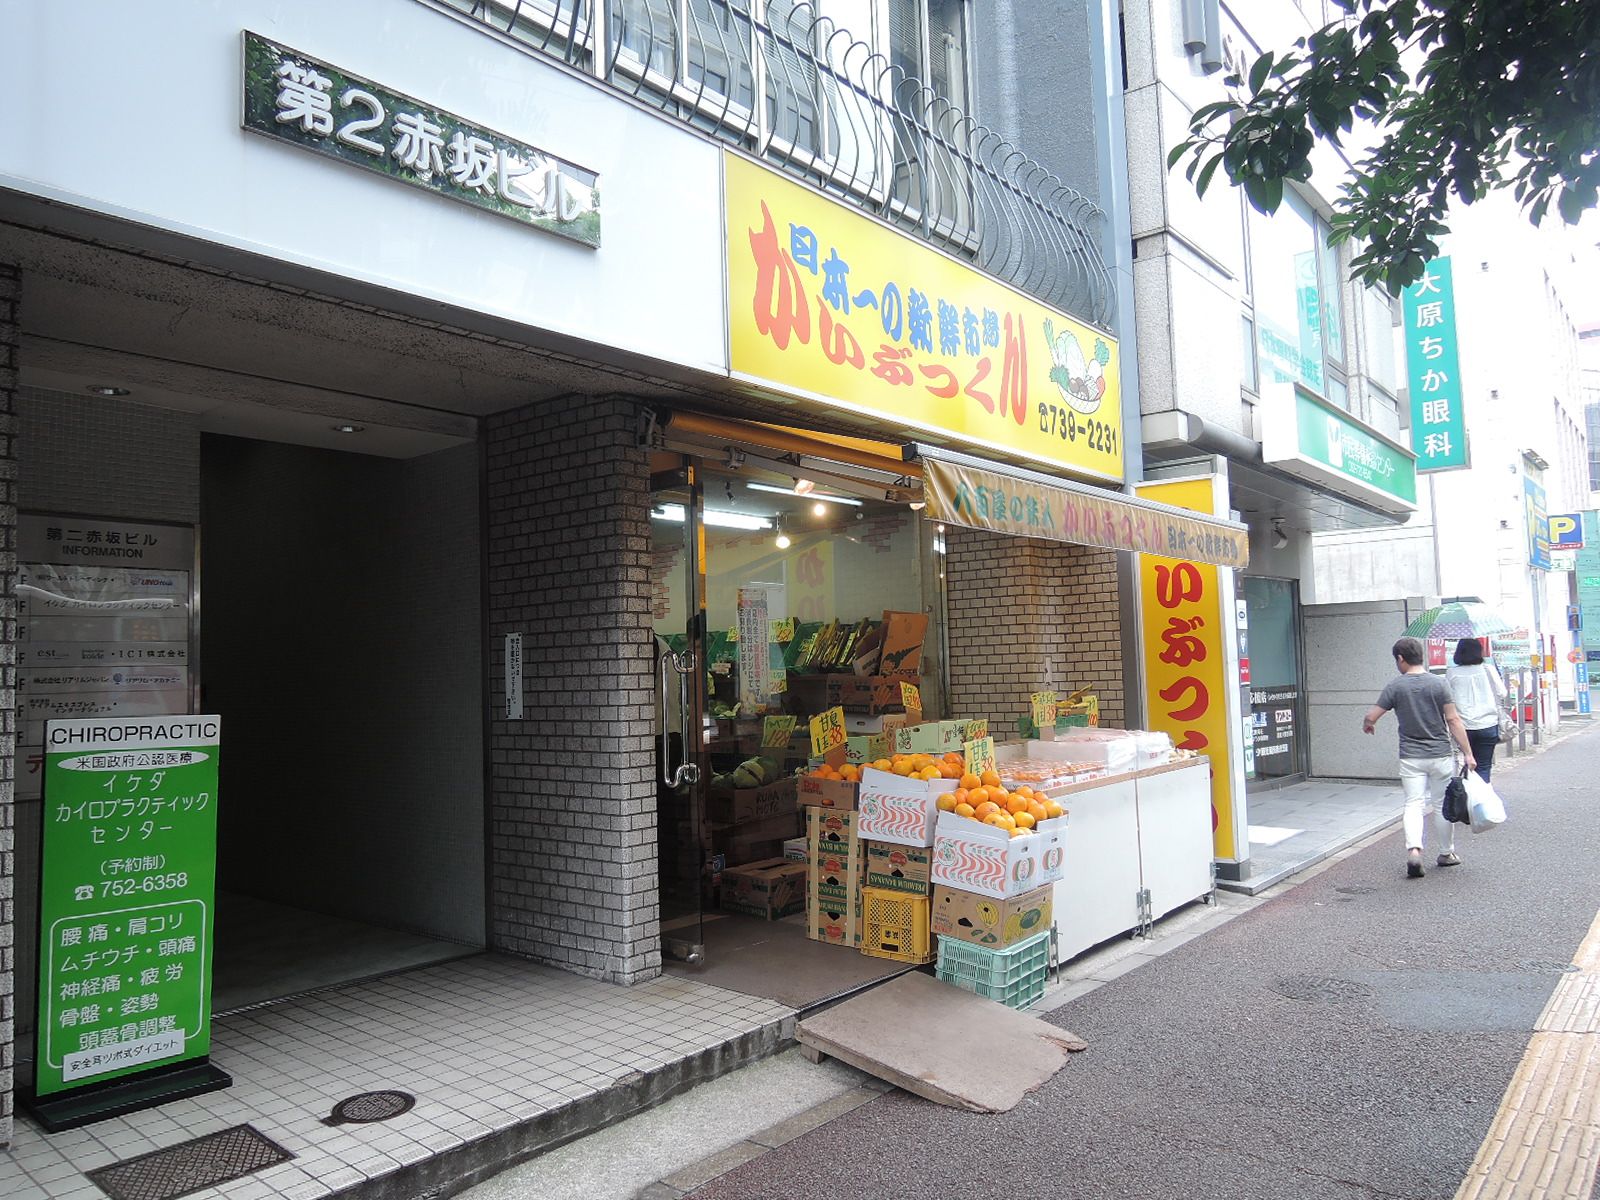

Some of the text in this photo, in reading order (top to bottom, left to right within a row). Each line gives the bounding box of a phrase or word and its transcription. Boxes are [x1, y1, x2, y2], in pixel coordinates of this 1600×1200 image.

[275, 61, 583, 222] 第2赤坂ビル
[789, 222, 1000, 357] 日本一の新鮮市場
[1413, 269, 1453, 458] 大原ちか眼科
[1048, 404, 1118, 457] 739-2231
[46, 528, 158, 545] 第二赤坂ビル
[1548, 516, 1576, 544] P
[62, 545, 144, 558] INFORMATION
[51, 722, 218, 744] CHIROPRACTIC
[76, 751, 193, 769] 米国政府公認医療
[103, 770, 166, 793] イケダ
[55, 792, 210, 822] カイロプラクティック
[90, 820, 173, 844] センター
[100, 854, 166, 875] (予約制)
[100, 872, 188, 898] 752-6358
[60, 912, 184, 947] 腰痛・肩コリ
[60, 935, 196, 973] ムチウチ・頭痛
[59, 962, 184, 1001] 神経痛・疲労
[59, 992, 160, 1028] 骨盤・姿勢
[79, 1014, 177, 1051] 頭蓋骨調整
